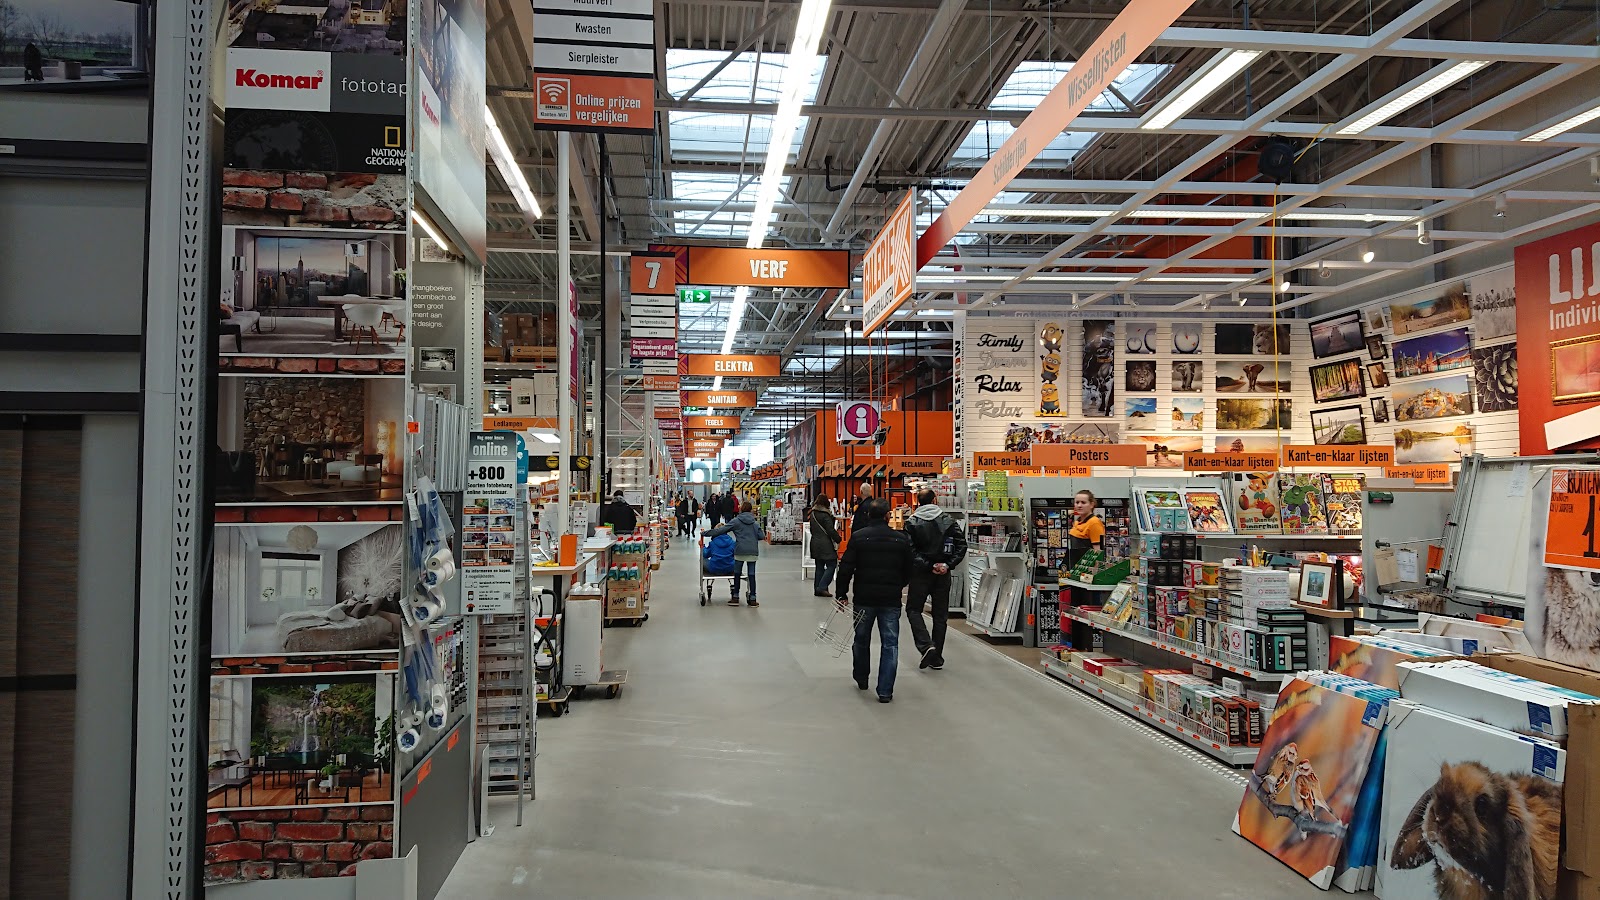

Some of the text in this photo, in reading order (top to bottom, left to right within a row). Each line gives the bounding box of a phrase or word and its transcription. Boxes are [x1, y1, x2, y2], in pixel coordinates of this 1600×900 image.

[575, 22, 612, 34] Kwasten
[568, 51, 619, 65] Sierpleister
[1068, 31, 1127, 110] Wissellijsten
[235, 69, 324, 90] Komar
[575, 93, 641, 110] Online prijzen
[575, 109, 629, 125] vergelijken
[365, 156, 407, 167] GEOGRAP
[645, 261, 662, 290] 7
[749, 259, 789, 279] VERF
[1549, 300, 1600, 331] Indivi
[977, 334, 1024, 352] Family
[714, 360, 754, 373] ELEKTRA
[974, 374, 1023, 394] Relax
[707, 395, 738, 404] SANITAIR
[974, 400, 1024, 420] Relax
[493, 419, 523, 428] Ledlampen
[704, 419, 724, 427] TEGELS
[472, 442, 508, 456] online
[1070, 449, 1109, 461] Posters
[1188, 457, 1274, 469] Kant-en-klaar lijsten
[1288, 450, 1389, 465] Kant-en-klaar lijsten
[468, 466, 505, 480] +800
[1387, 468, 1446, 480] Kant-en-klaar lijsten
[1229, 711, 1240, 736] GARAGE
[1250, 711, 1260, 735] GARAGE
